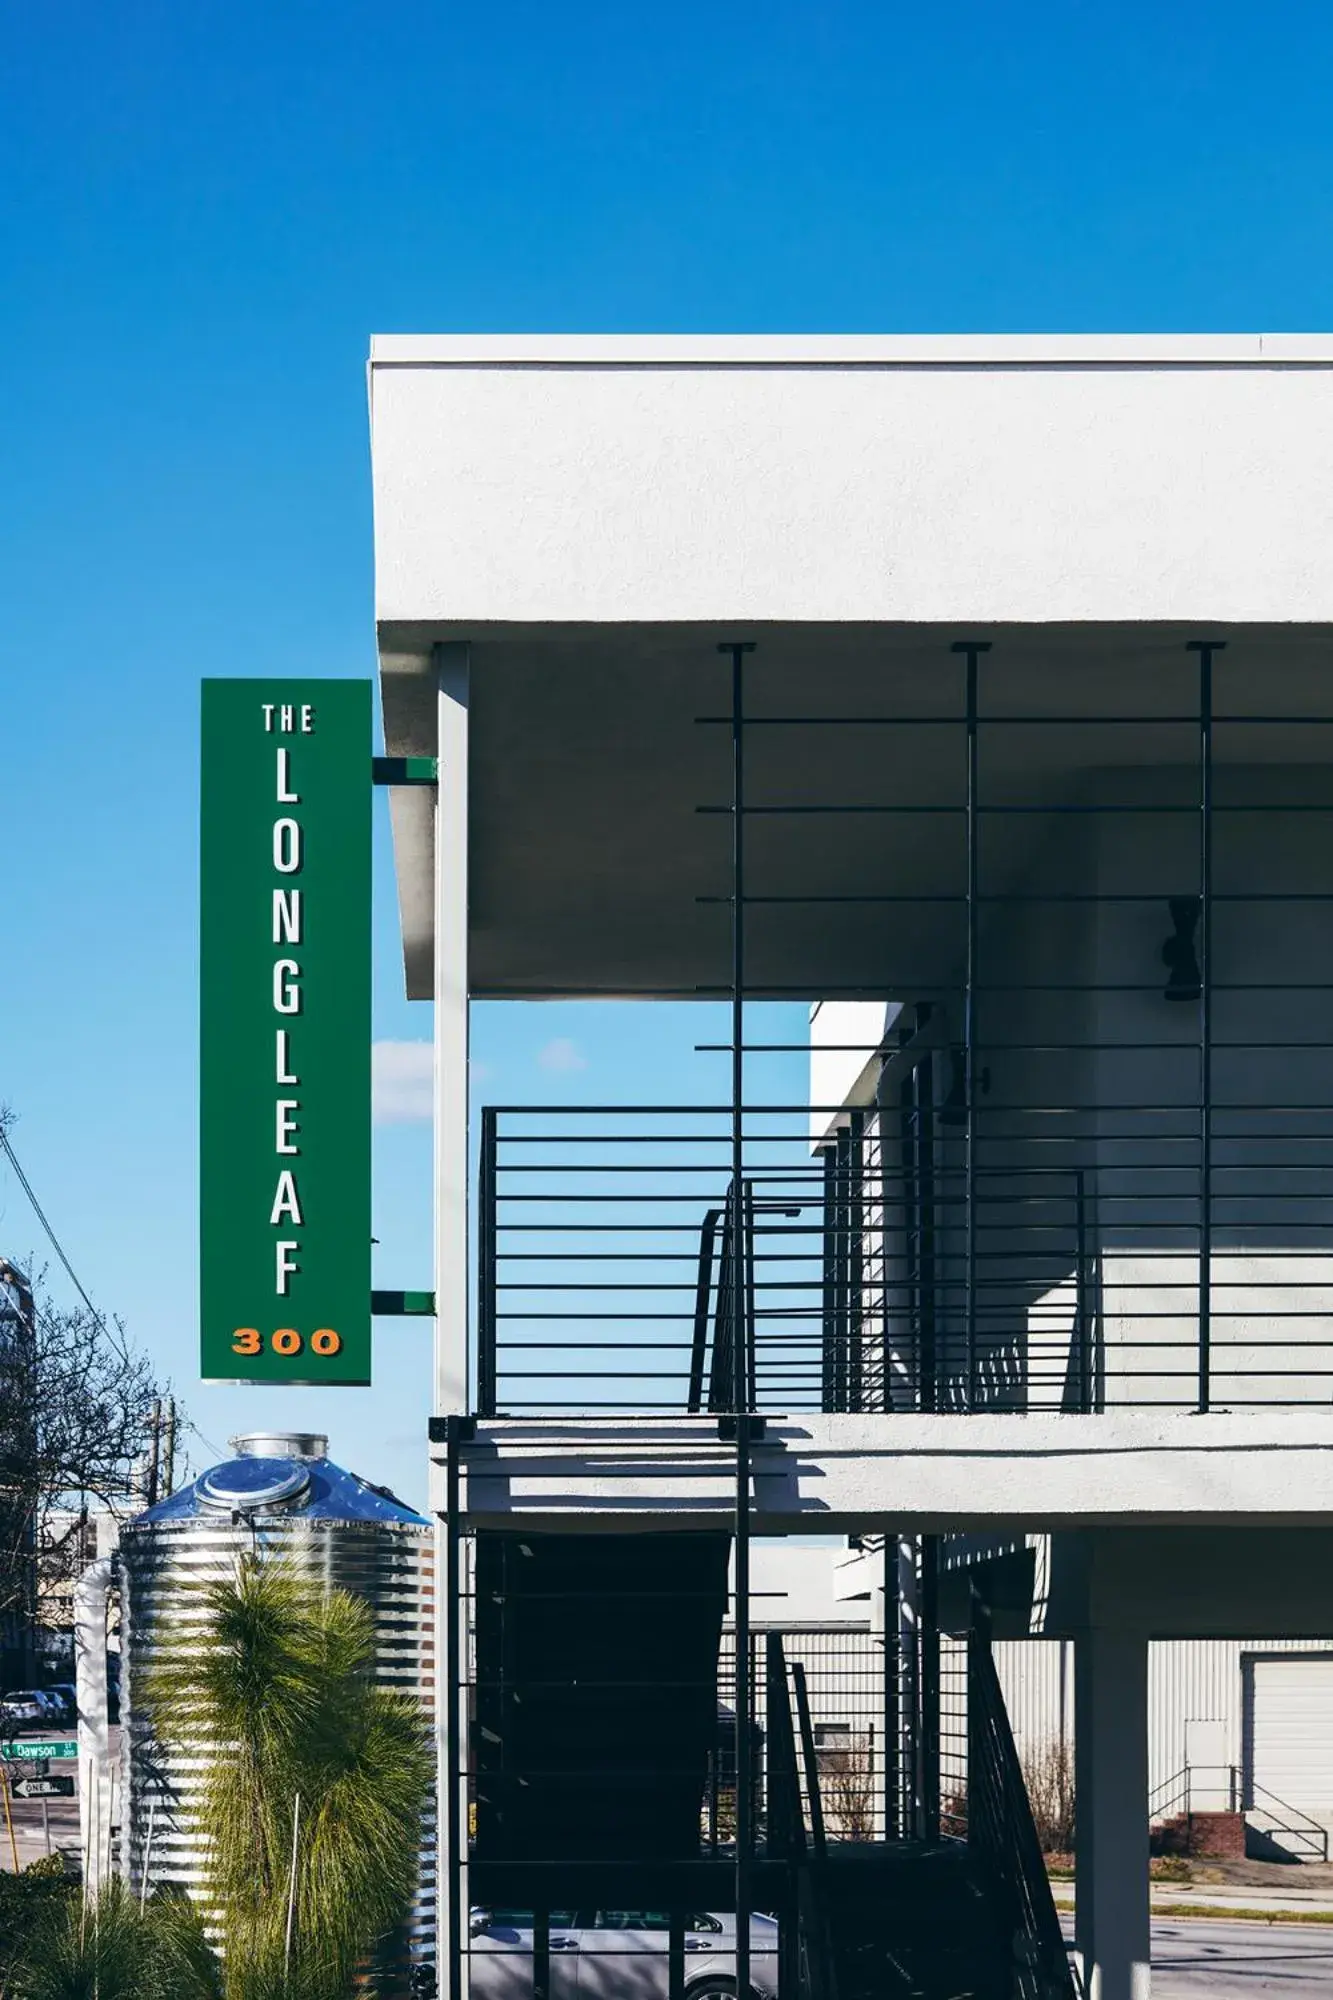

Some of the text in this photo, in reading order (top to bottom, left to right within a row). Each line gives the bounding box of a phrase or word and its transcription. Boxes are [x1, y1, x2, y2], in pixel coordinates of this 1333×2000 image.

[262, 704, 312, 732] THE
[270, 747, 302, 1295] LONGLEAF
[231, 1327, 341, 1356] 300
[17, 1744, 56, 1757] Dawson
[26, 1784, 44, 1793] ONE
